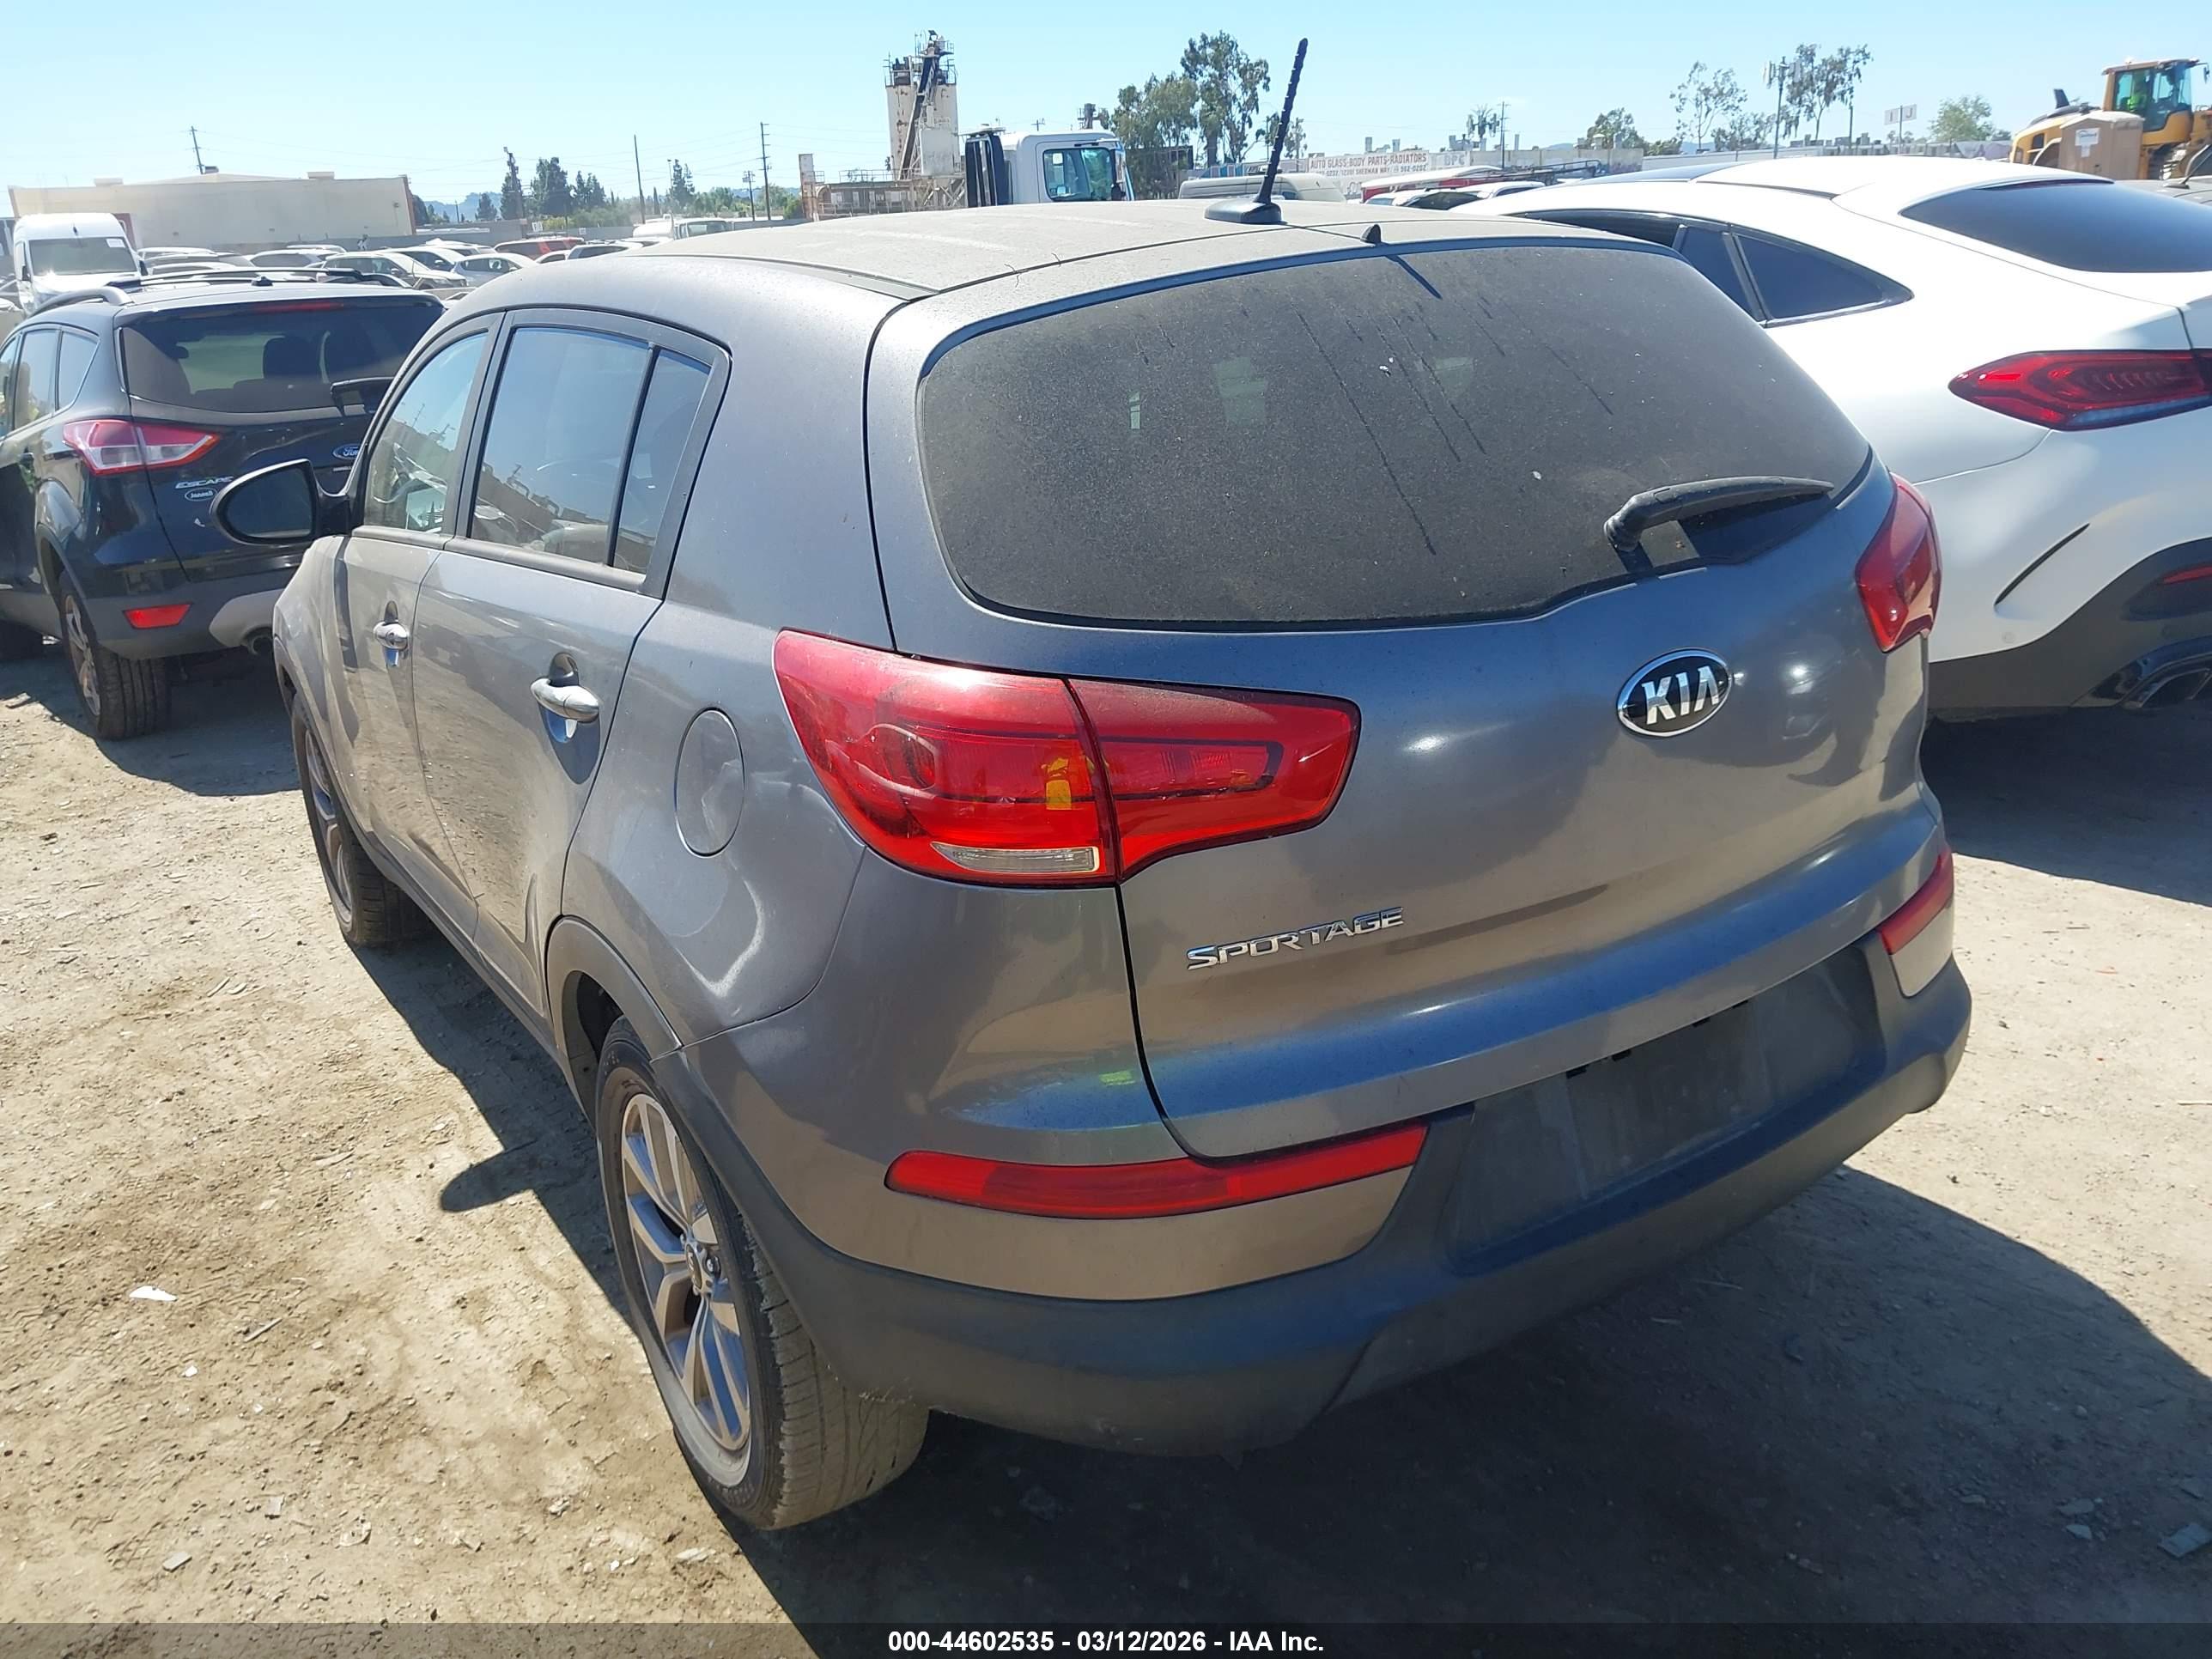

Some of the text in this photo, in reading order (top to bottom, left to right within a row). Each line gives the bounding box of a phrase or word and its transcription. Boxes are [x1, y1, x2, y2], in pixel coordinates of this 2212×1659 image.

[1905, 107, 1913, 118] J
[1310, 158, 1326, 169] AUTO
[174, 476, 234, 489] ESCAPE
[1641, 665, 1720, 725] KIA
[1185, 906, 1405, 971] SPORTAGE
